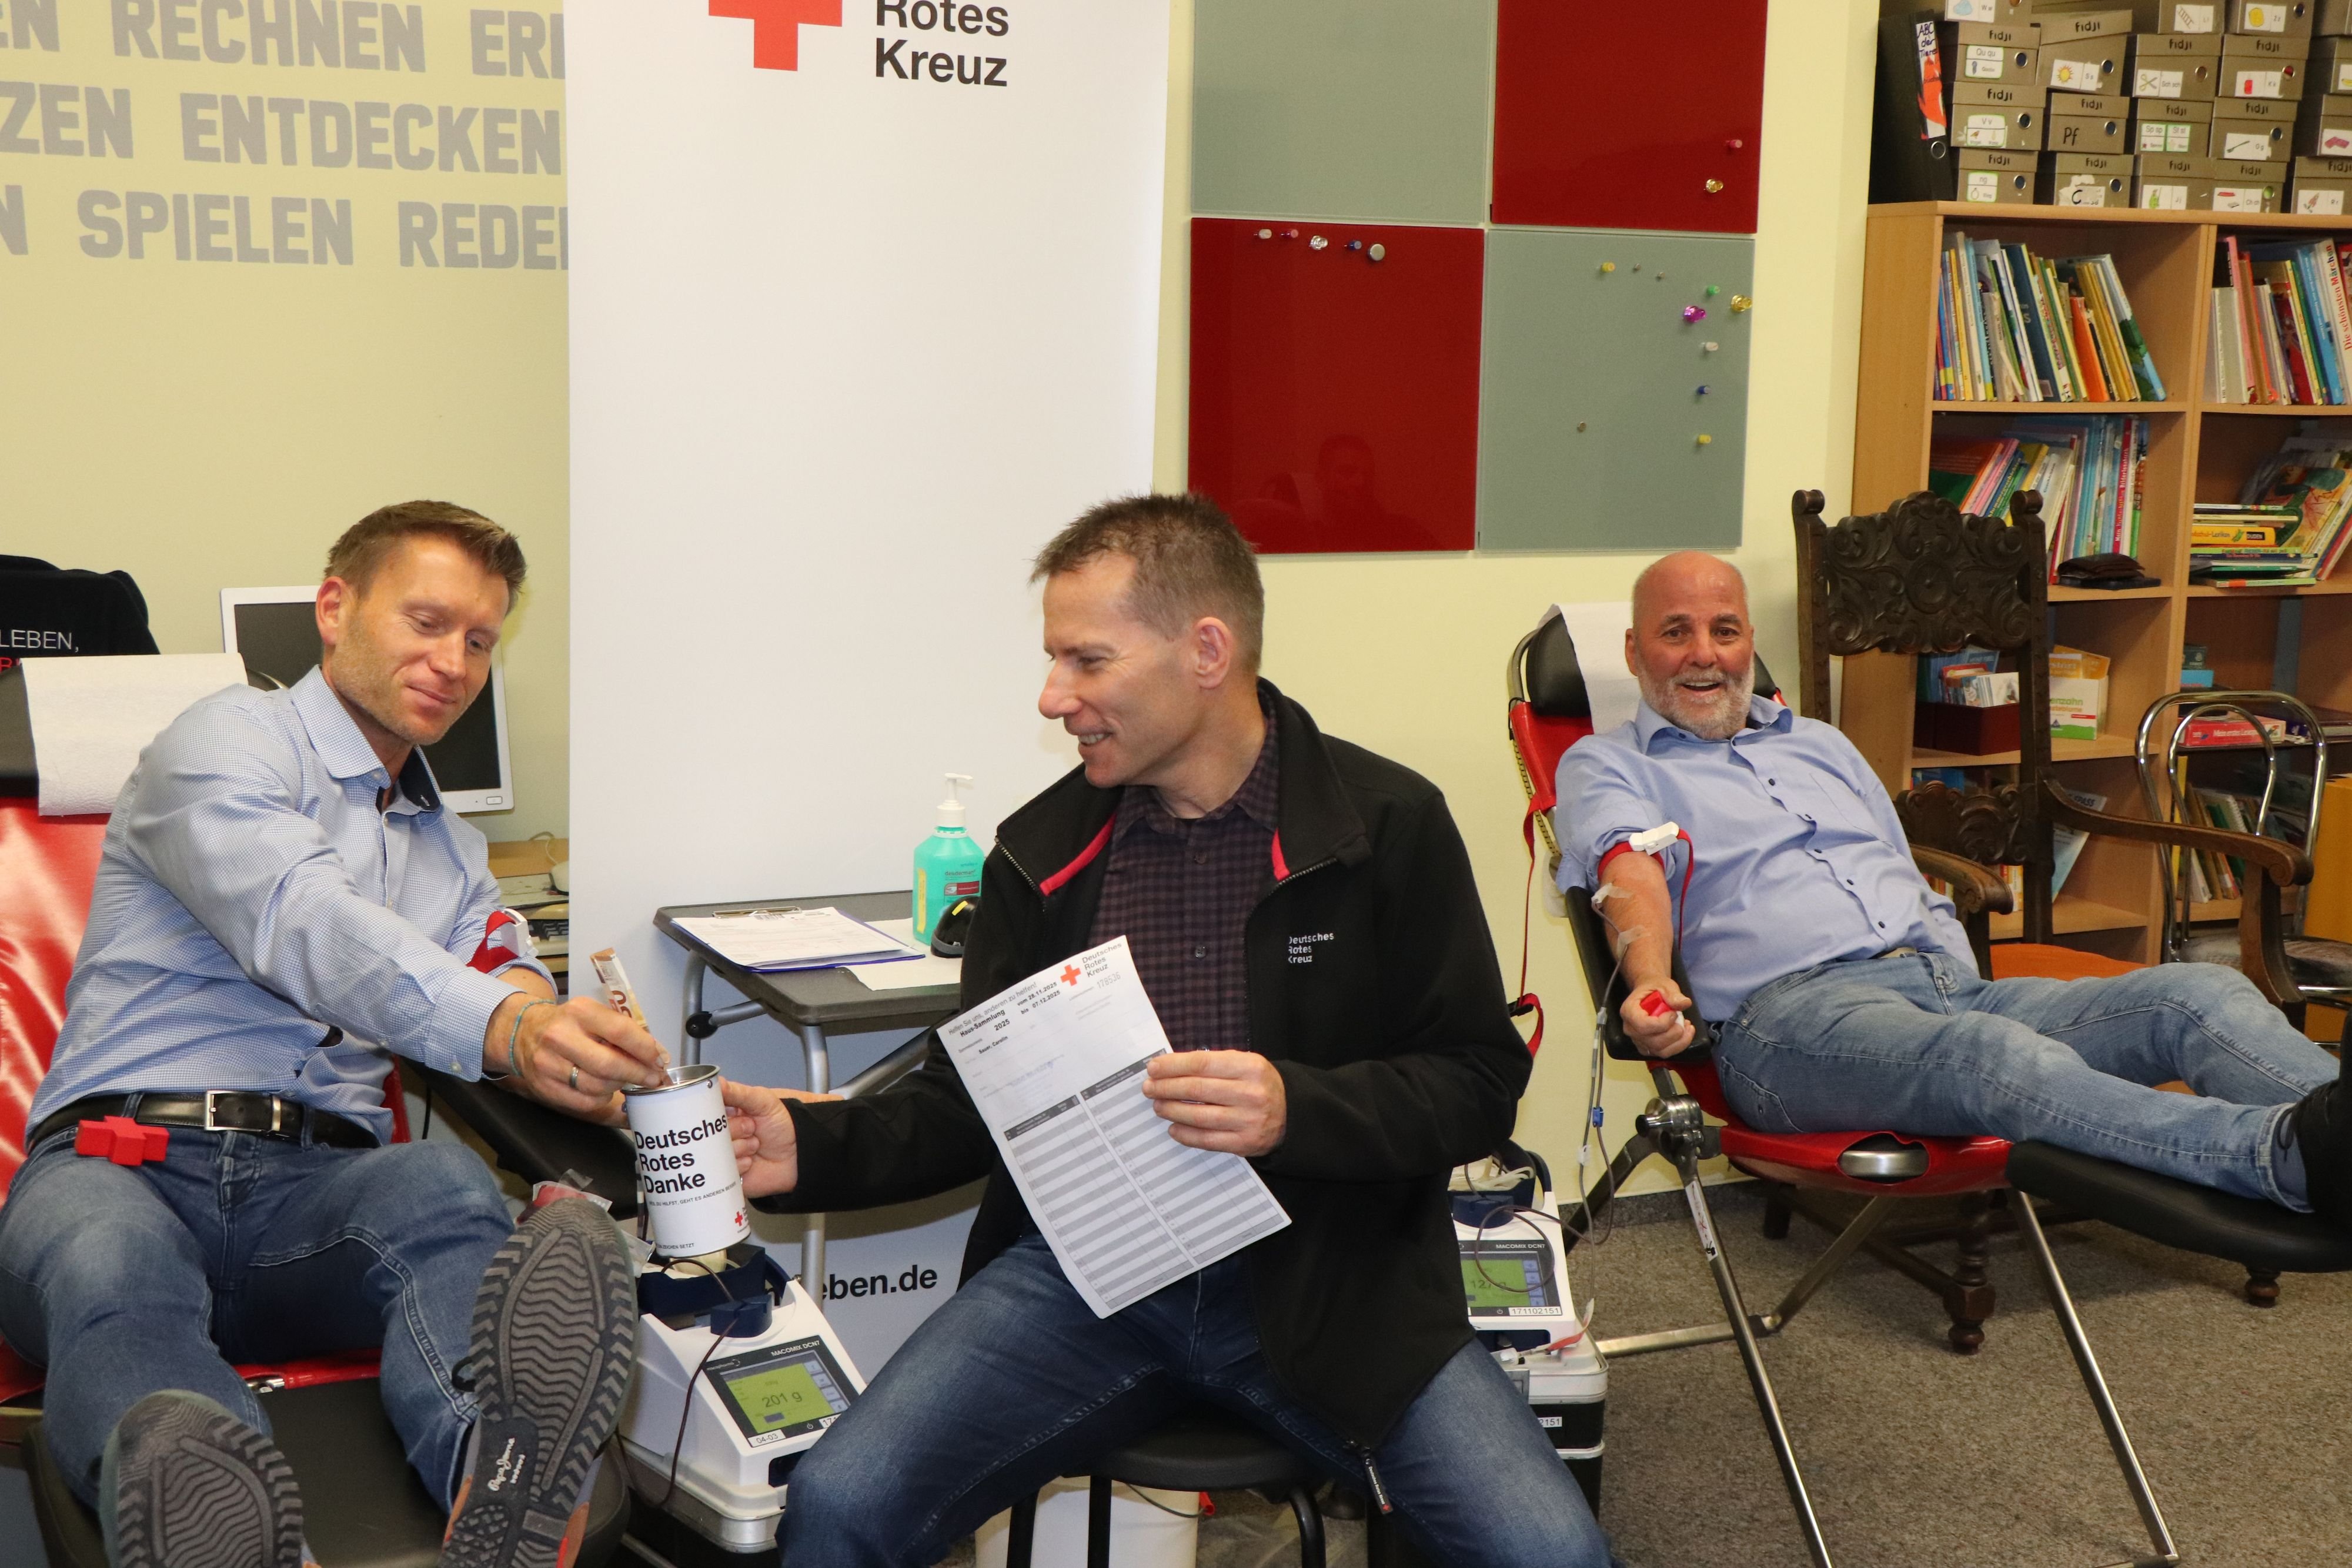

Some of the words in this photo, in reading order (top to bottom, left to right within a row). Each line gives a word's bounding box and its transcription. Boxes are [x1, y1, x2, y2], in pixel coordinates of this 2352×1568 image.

[876, 0, 1009, 37] Rotes
[2076, 21, 2101, 32] fidji
[0, 0, 60, 52] N
[112, 0, 426, 73] RECHNEN
[1916, 22, 1934, 39] ABC
[1989, 30, 2012, 42] fidji
[1921, 37, 1936, 48] der
[2169, 39, 2192, 51] fidji
[2256, 40, 2280, 52] fidji
[876, 38, 1008, 88] Kreuz
[1987, 88, 2013, 101] fidji
[2082, 99, 2102, 110] fidji
[2166, 105, 2187, 116] fidji
[2246, 102, 2269, 114] fidji
[180, 92, 562, 176] ENTDECKEN
[2063, 127, 2080, 146] Pf
[1989, 154, 2010, 165] fidji
[2086, 158, 2107, 169] fidji
[2169, 161, 2190, 171] fidji
[2240, 165, 2261, 175] fidji
[77, 190, 353, 266] SPIELEN
[2326, 245, 2339, 286] Märchen
[2335, 286, 2349, 333] schönsten
[2344, 335, 2352, 351] Die
[1082, 942, 1122, 964] Deutsches
[1084, 957, 1106, 970] Rotes
[1087, 964, 1108, 977] Kreuz
[1097, 972, 1121, 989] 178536
[1017, 998, 1028, 1007] vom
[1028, 981, 1058, 1000] 28.11.2025
[948, 1023, 964, 1035] Helfen
[963, 1019, 973, 1028] Sie
[984, 999, 1008, 1018] anderen
[1008, 994, 1016, 1002] zu
[1015, 981, 1037, 998] helfen!
[1021, 1007, 1030, 1015] bis
[1032, 990, 1061, 1009] 07.12.2025
[960, 1009, 1006, 1038] Haus-Sammlung
[994, 1019, 1011, 1031] 2025
[992, 1035, 1009, 1048] Carolin
[634, 1114, 727, 1150] Deutsches
[639, 1152, 695, 1172] Rotes
[644, 1173, 706, 1195] Danke
[703, 1189, 725, 1199] ANDEREN
[771, 1345, 802, 1357] MACOMIX
[803, 1340, 820, 1349] DCN7
[762, 1392, 789, 1408] 201
[792, 1392, 803, 1403] g
[756, 1433, 779, 1444] 04-03
